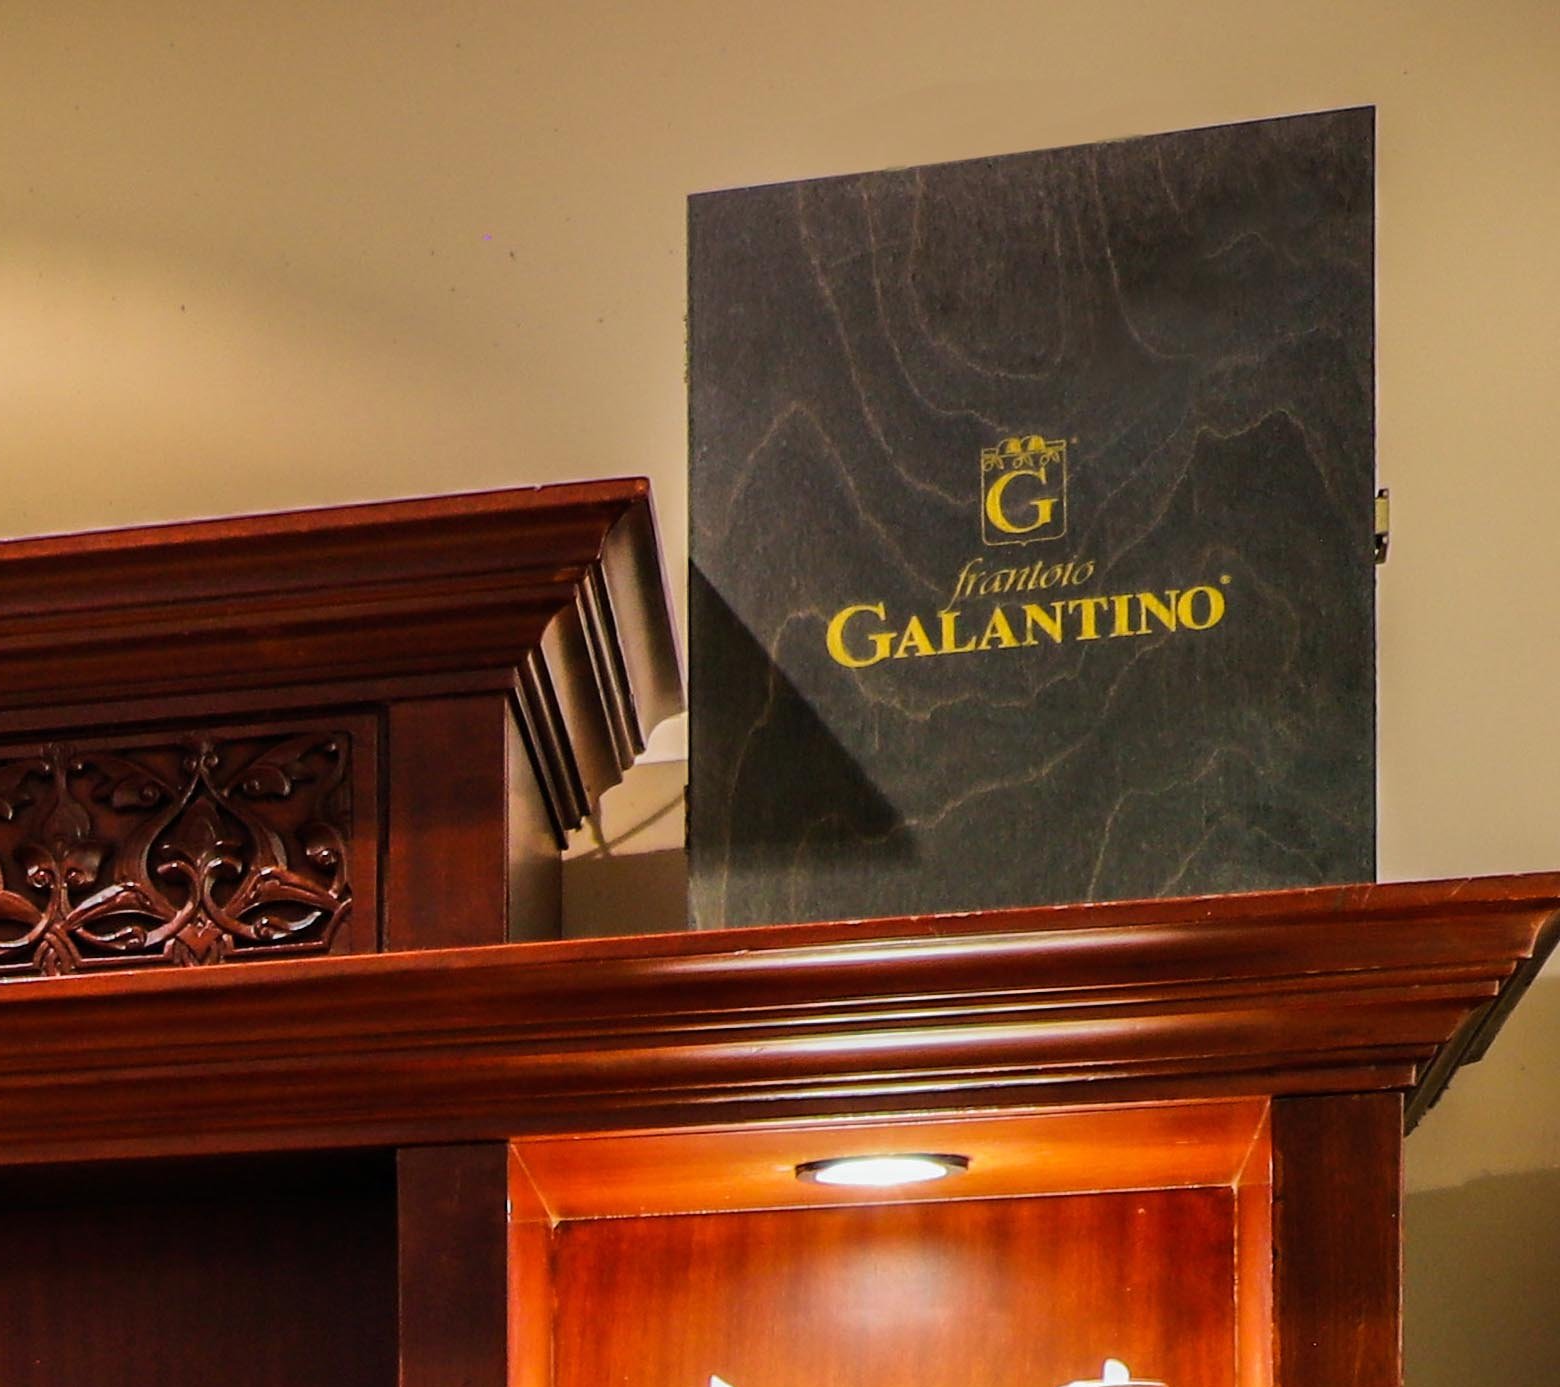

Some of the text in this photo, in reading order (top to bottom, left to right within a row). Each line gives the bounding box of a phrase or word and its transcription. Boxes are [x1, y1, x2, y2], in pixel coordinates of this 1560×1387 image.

[985, 469, 1058, 534] G
[946, 556, 1094, 611] frantoio
[826, 586, 1226, 668] GALANTINO
